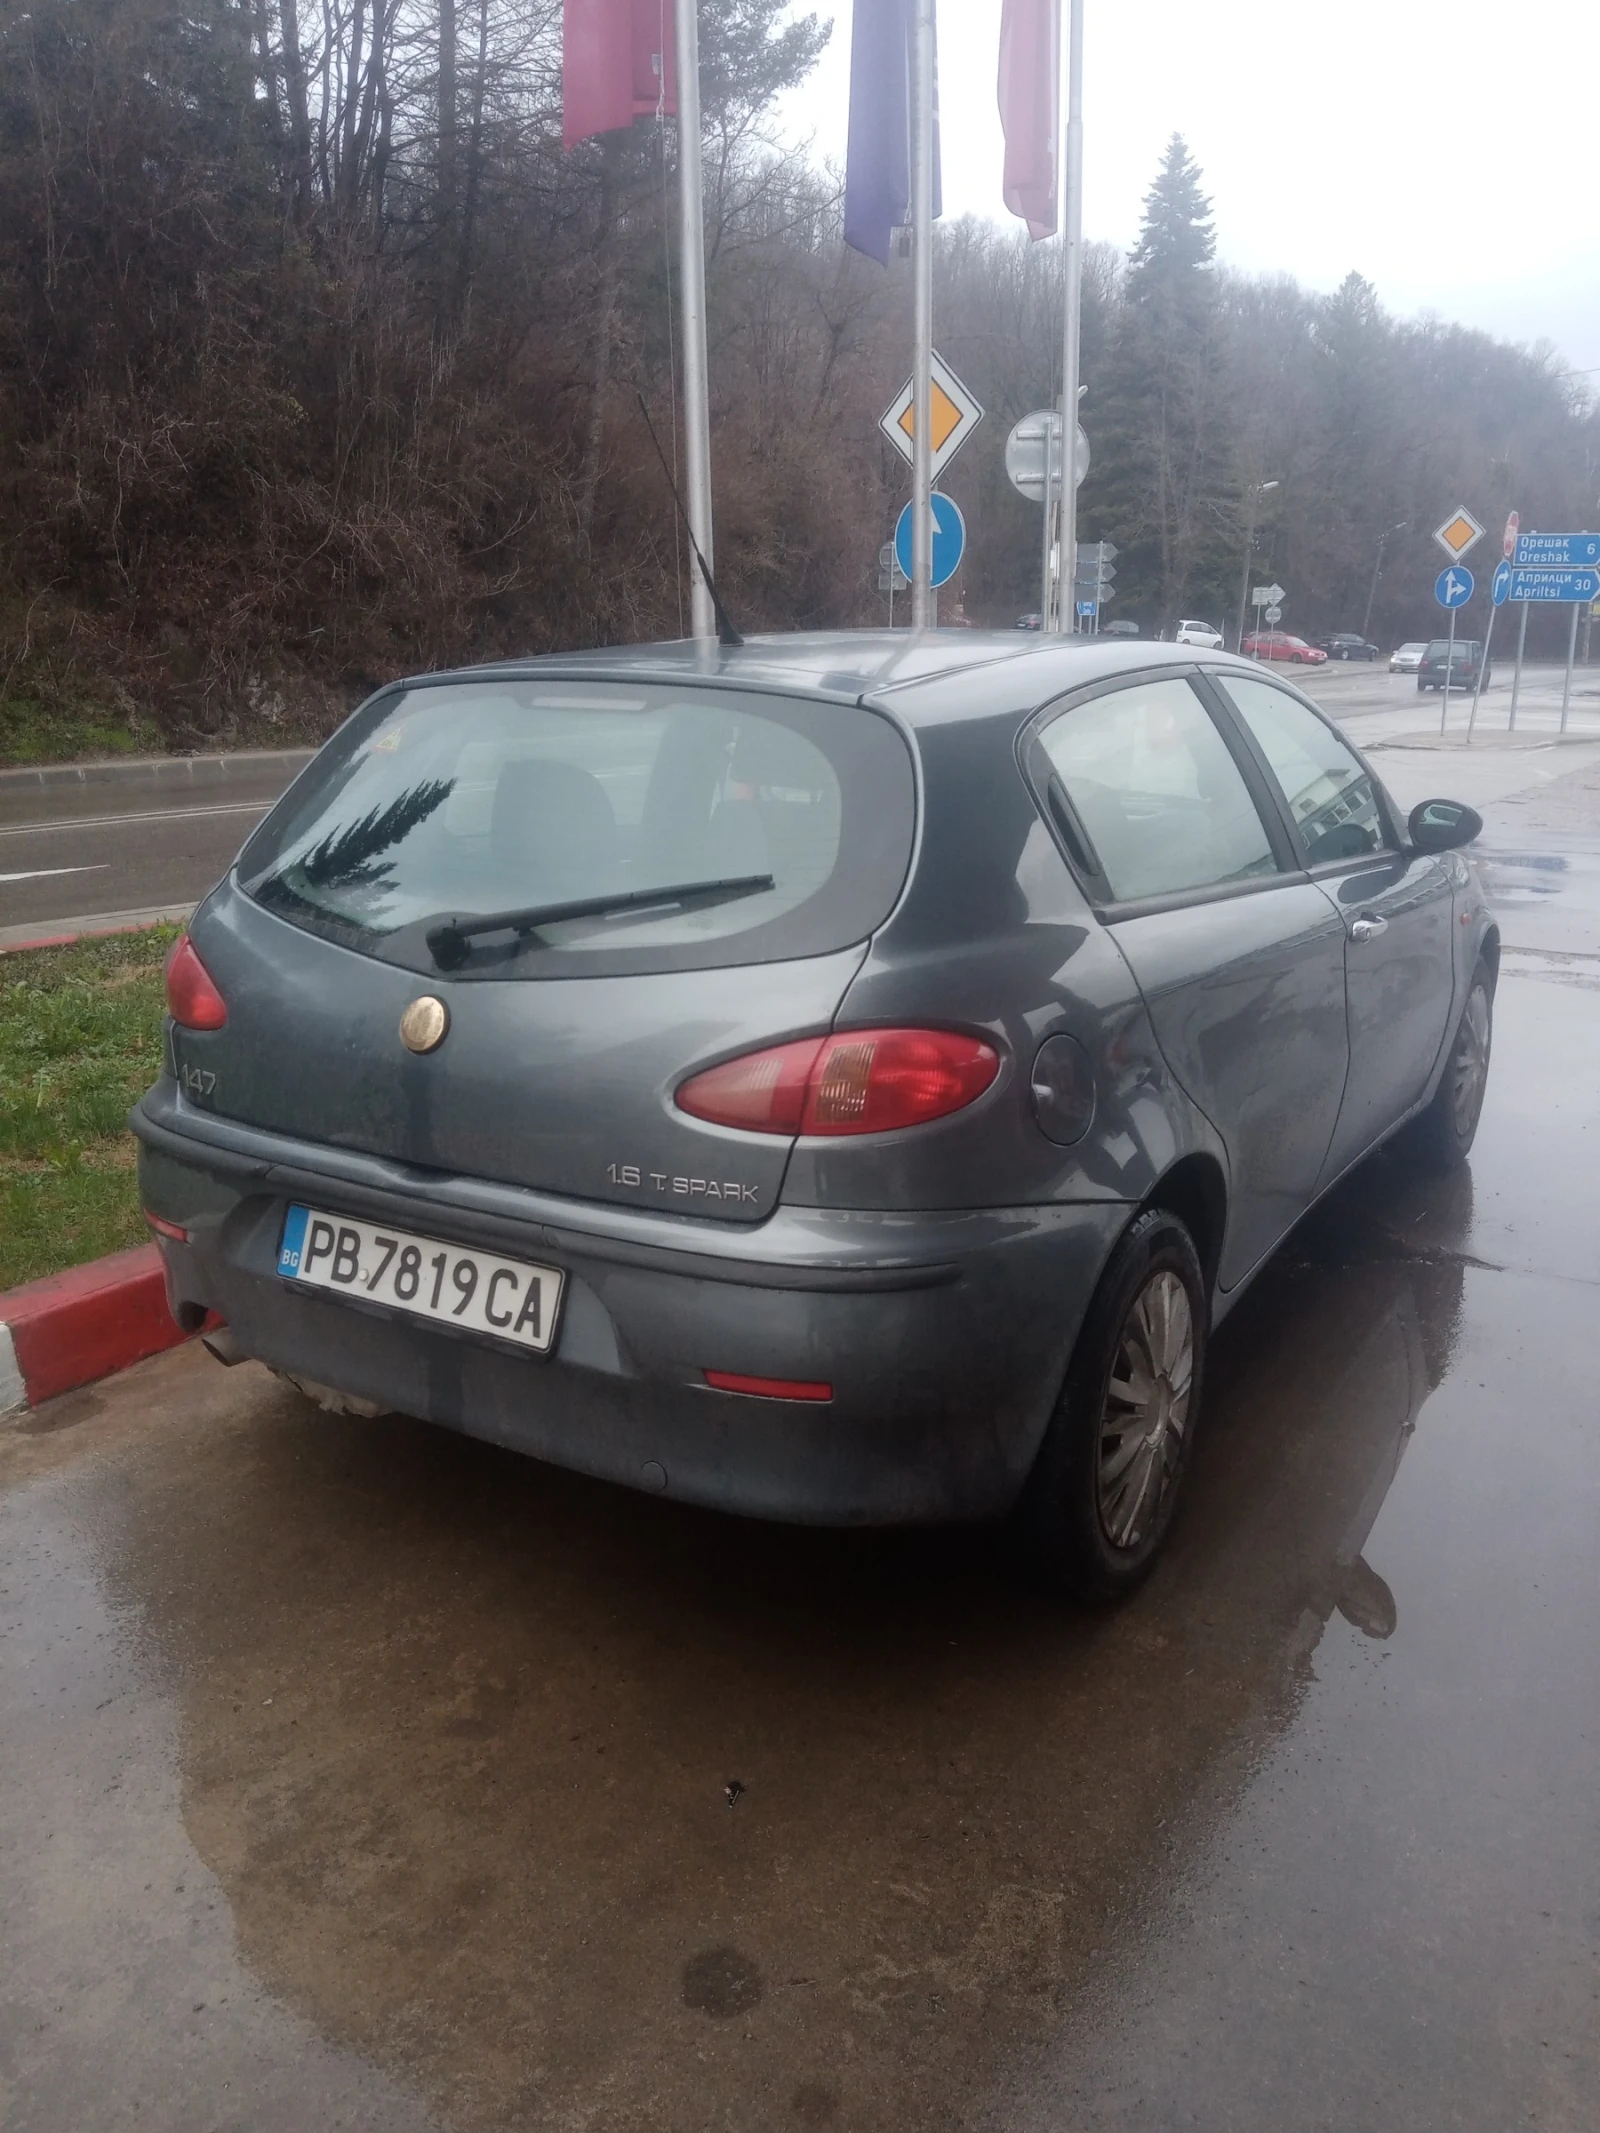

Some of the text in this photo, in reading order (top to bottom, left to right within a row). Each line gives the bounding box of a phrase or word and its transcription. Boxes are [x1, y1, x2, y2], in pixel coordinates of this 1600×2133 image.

[1521, 537, 1596, 555] Орешак 6
[1519, 551, 1570, 562] Oreshak
[1517, 571, 1591, 591] Априлци 30
[1515, 586, 1560, 600] Apriltsi
[182, 1064, 215, 1094] 147
[672, 1177, 758, 1203] SPARK
[281, 1249, 299, 1268] BG
